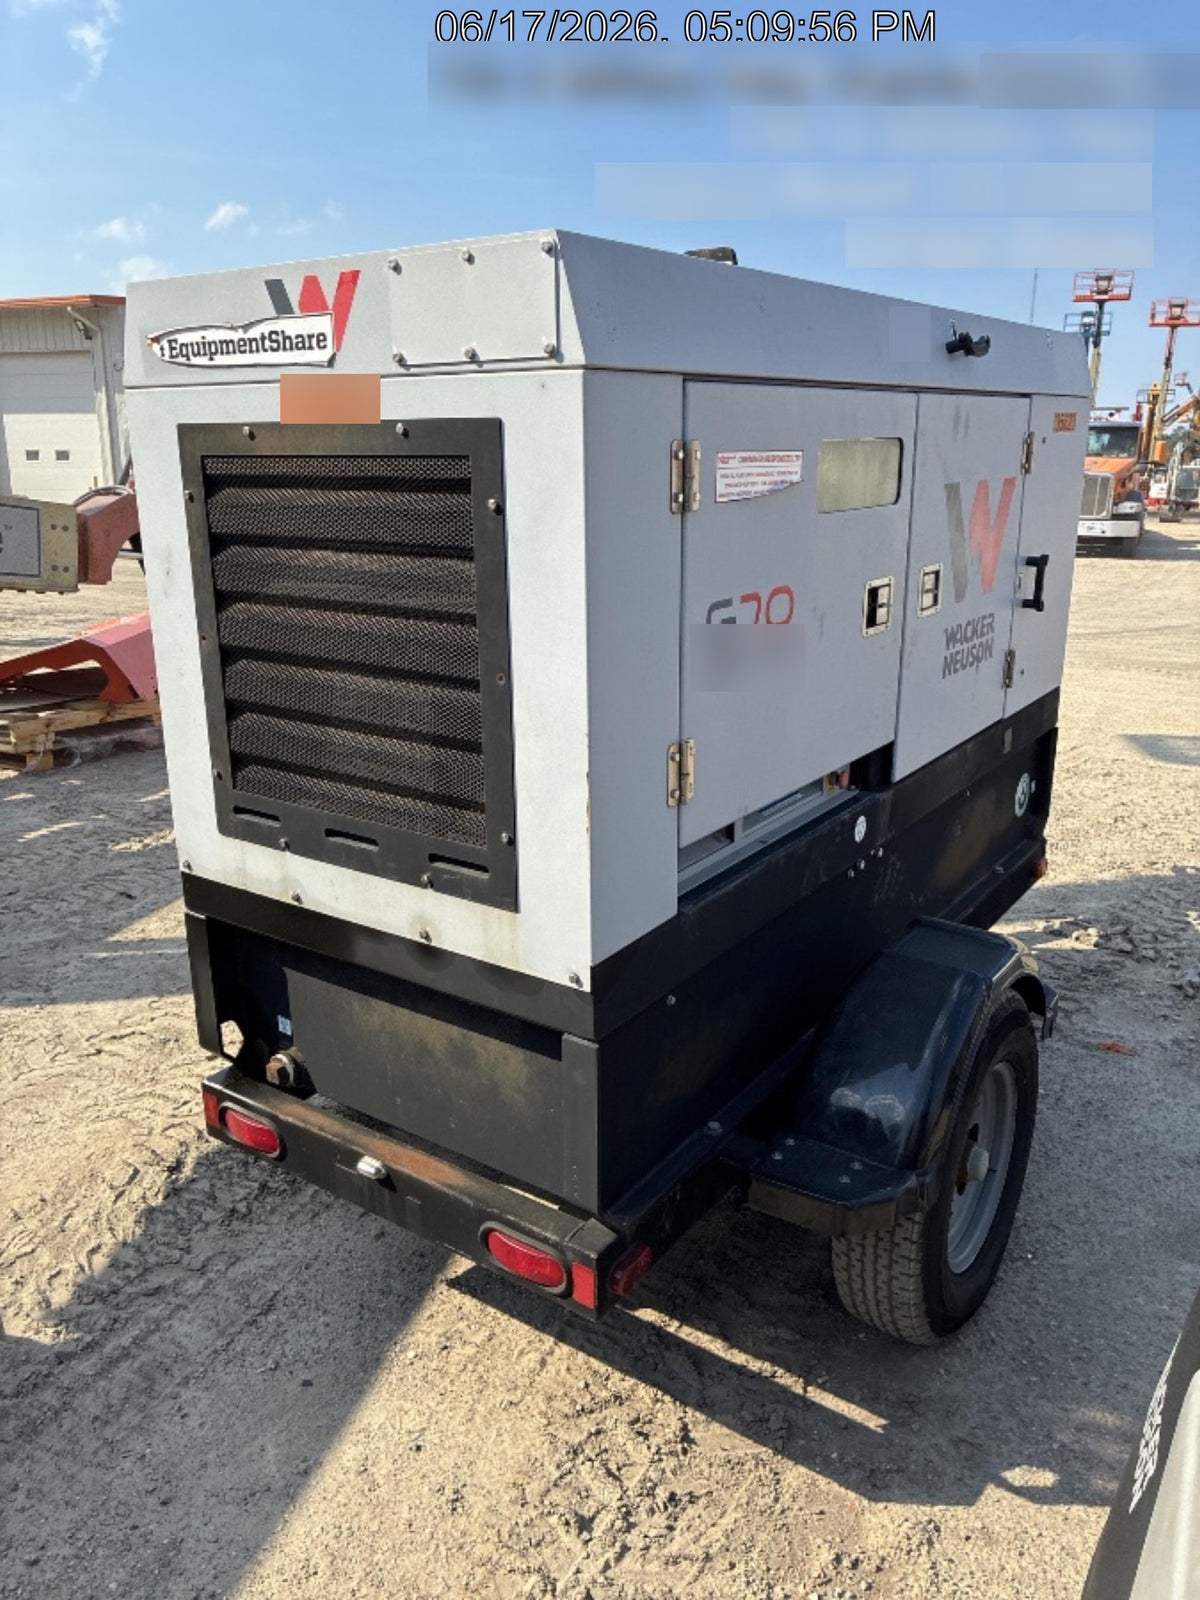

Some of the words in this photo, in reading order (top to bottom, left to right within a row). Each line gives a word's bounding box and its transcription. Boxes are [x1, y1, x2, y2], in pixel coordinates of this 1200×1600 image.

[166, 329, 328, 361] EquipmentShare
[944, 612, 996, 651] WACKER
[941, 635, 995, 680] NEUSON
